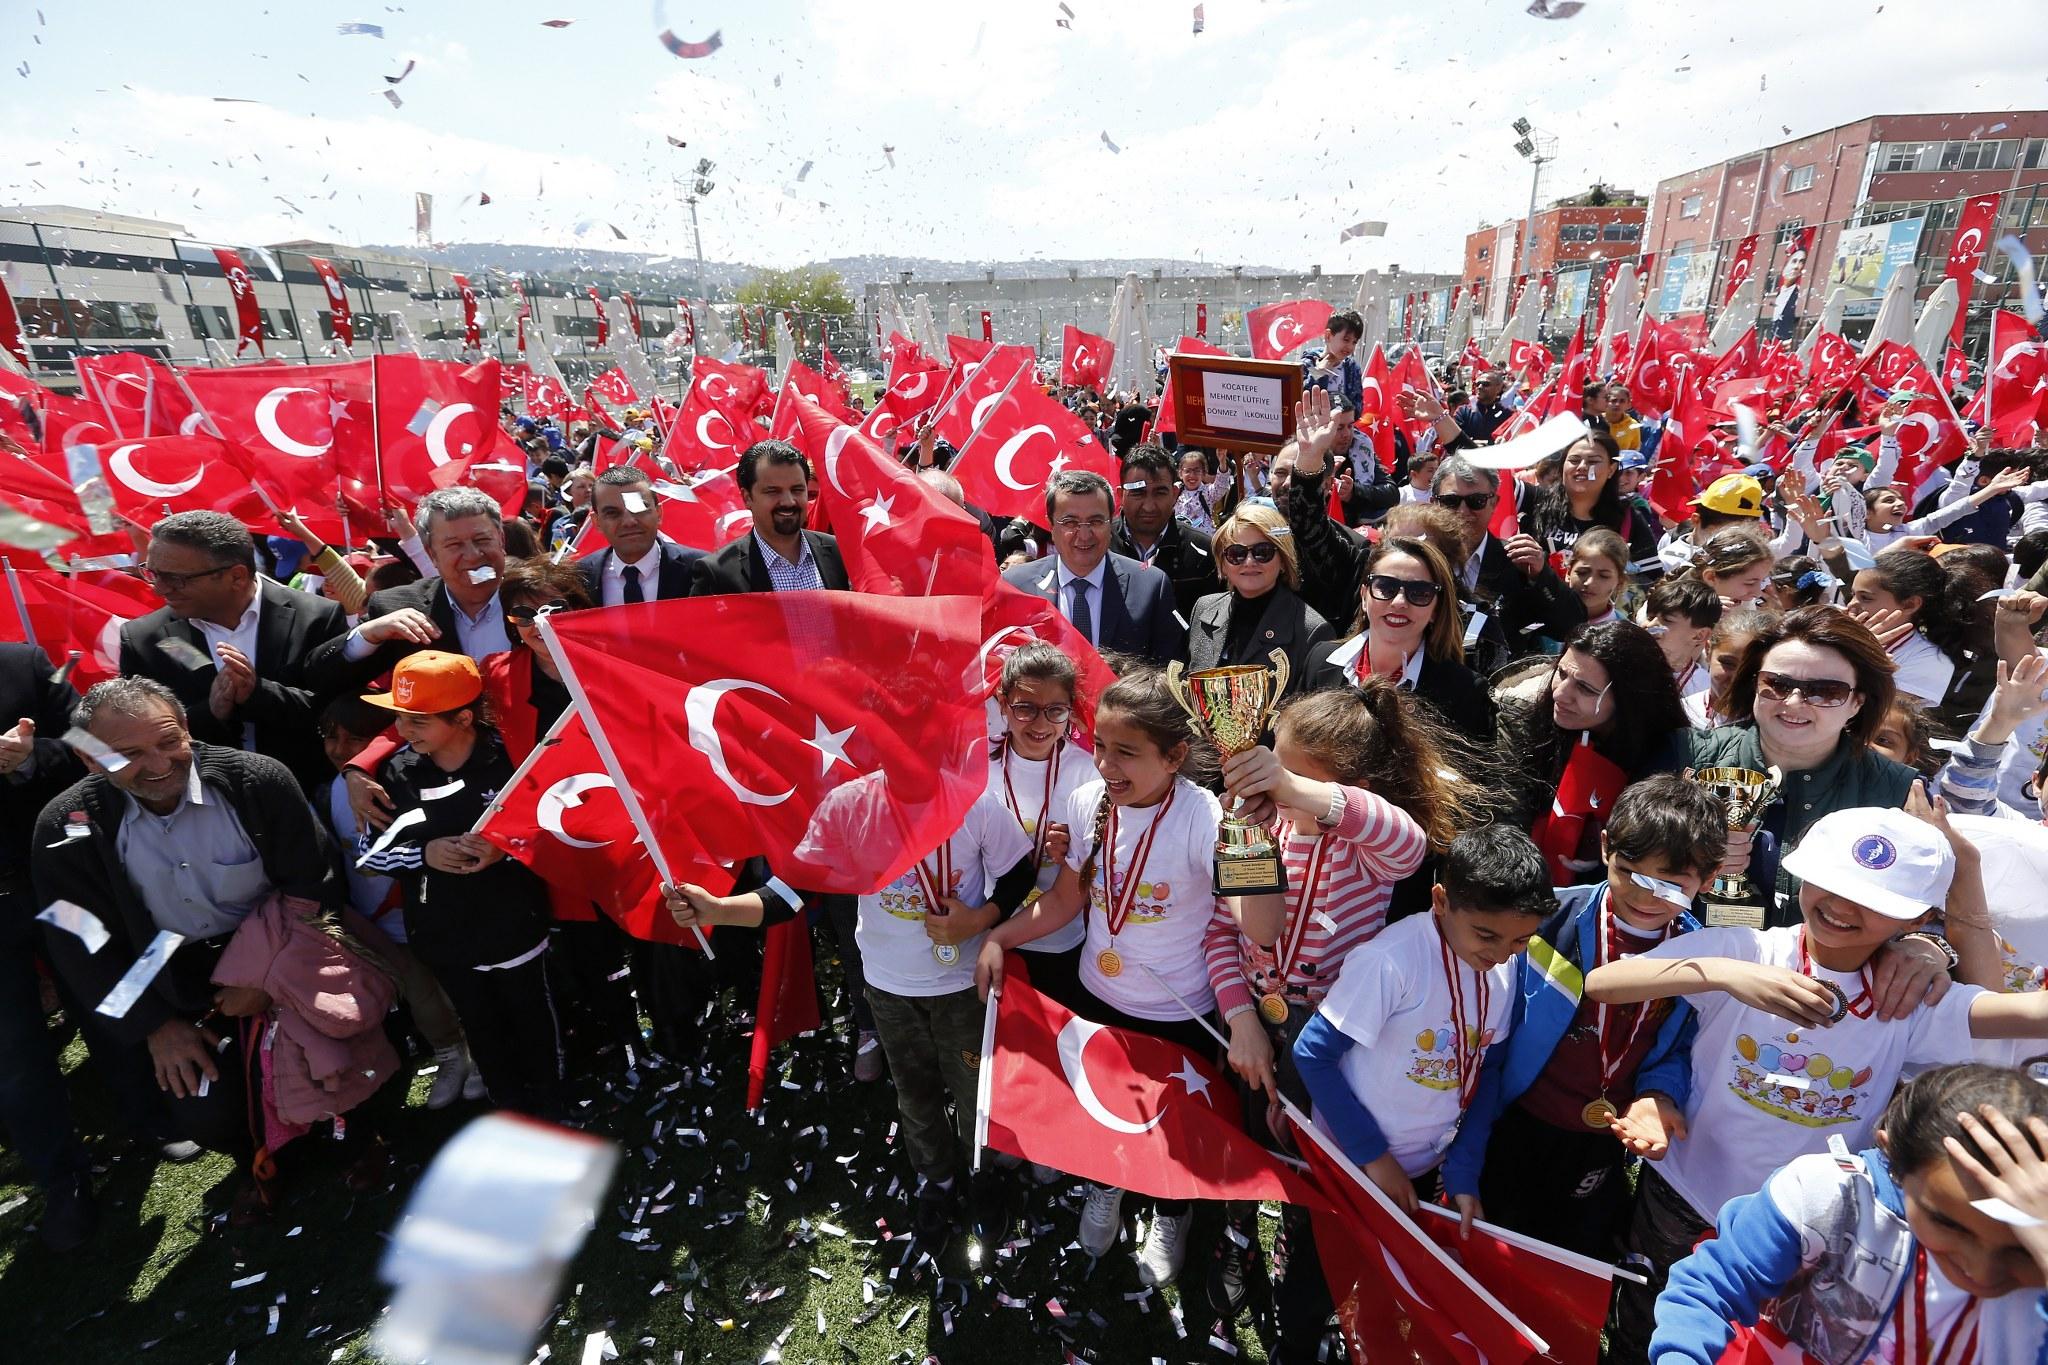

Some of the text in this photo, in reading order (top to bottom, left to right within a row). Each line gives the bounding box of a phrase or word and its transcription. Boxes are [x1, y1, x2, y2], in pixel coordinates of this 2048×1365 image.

[1221, 382, 1258, 393] KOCATEPE
[1186, 395, 1204, 406] MEH
[1209, 392, 1241, 402] MEHMET
